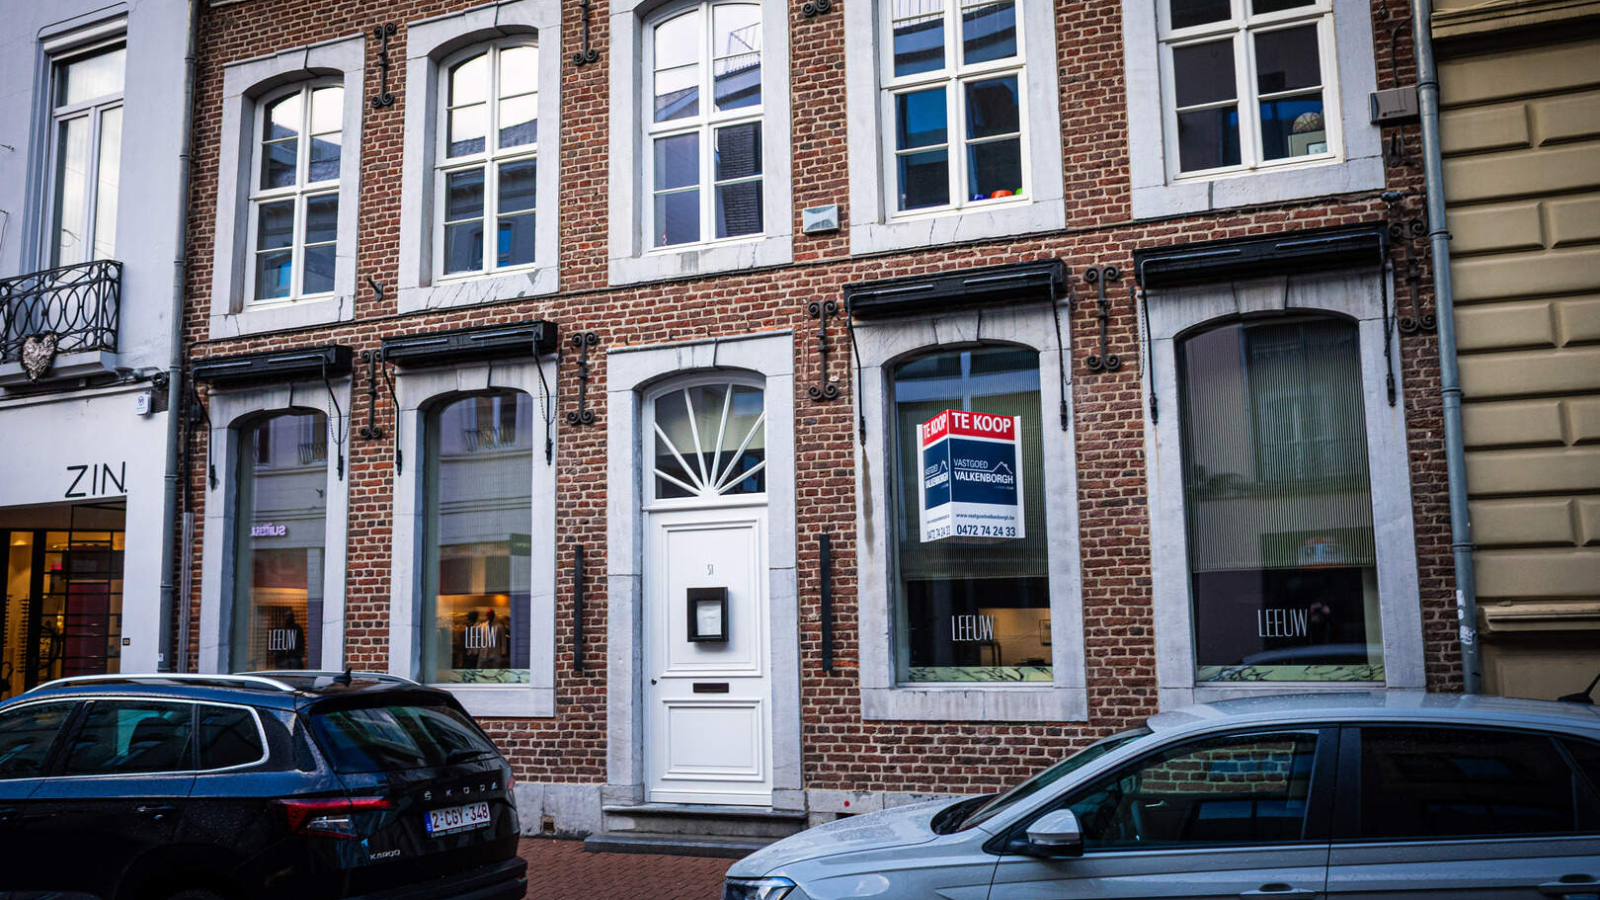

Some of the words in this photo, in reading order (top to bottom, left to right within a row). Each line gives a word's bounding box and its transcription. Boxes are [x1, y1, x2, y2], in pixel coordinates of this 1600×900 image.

[923, 423, 931, 439] TE
[930, 413, 947, 435] KOOP
[951, 412, 970, 429] TE
[973, 414, 1012, 433] KOOP
[953, 458, 989, 469] VASTGOED
[65, 461, 128, 498] ZIN.
[954, 470, 1014, 484] VALKENBORGH
[956, 524, 978, 535] 0472
[980, 525, 991, 536] 74
[993, 526, 1004, 537] 24
[1005, 526, 1016, 537] 33
[951, 614, 995, 641] LEEUW
[1257, 608, 1308, 637] LEEUW
[268, 629, 297, 651] LEEUW
[465, 626, 498, 649] LEEUW
